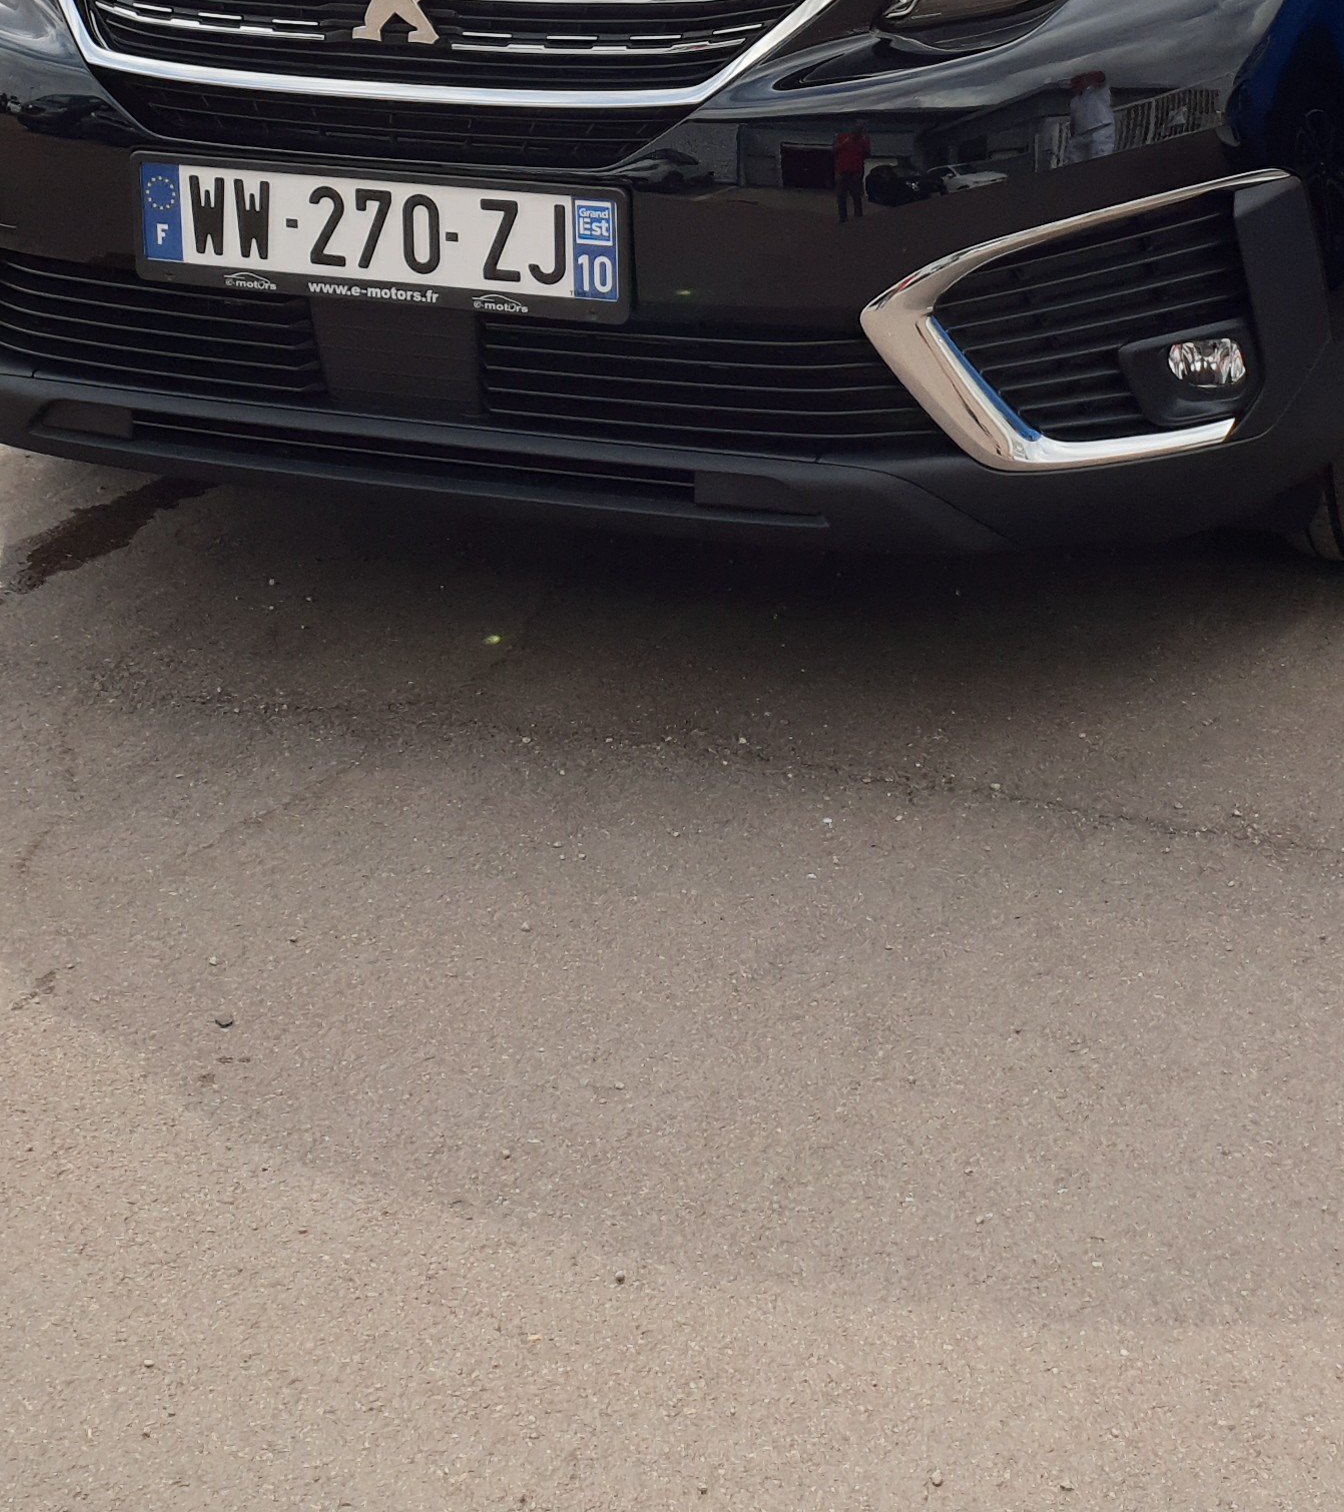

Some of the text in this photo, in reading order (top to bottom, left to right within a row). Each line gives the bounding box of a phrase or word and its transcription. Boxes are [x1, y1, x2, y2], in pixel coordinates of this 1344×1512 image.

[578, 207, 609, 219] Grand
[157, 223, 168, 246] F
[579, 217, 610, 237] Est
[577, 254, 613, 293] 10
[308, 280, 439, 304] www.e-motors.fr
